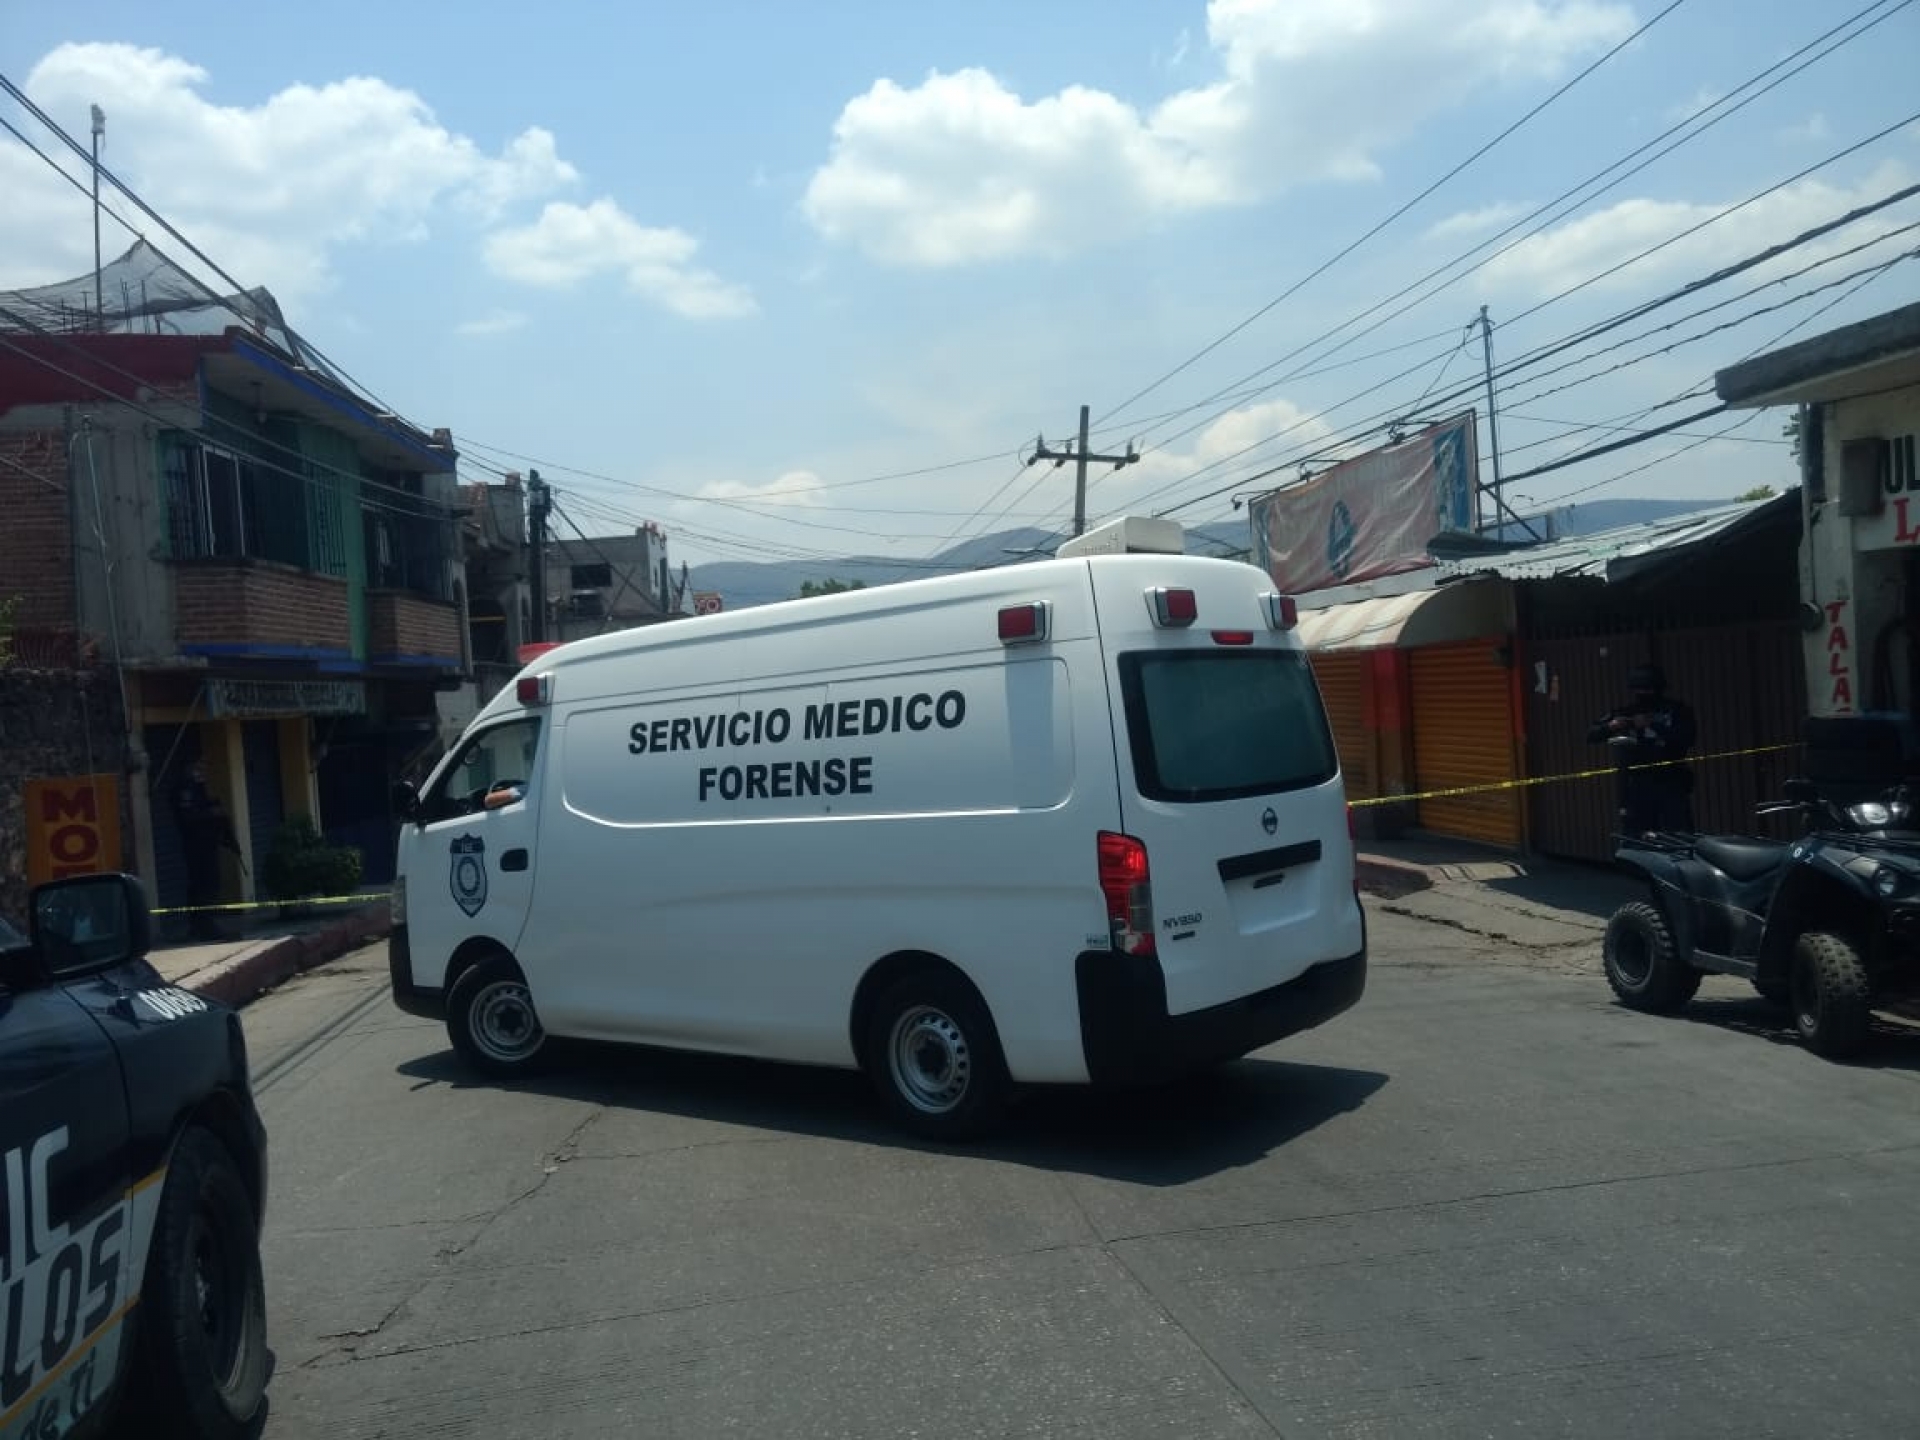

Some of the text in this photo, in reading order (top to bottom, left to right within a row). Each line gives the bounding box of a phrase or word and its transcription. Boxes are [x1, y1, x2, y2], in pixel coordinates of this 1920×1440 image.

[1824, 600, 1852, 713] TALA
[628, 690, 967, 754] SERVICIO MEDICO
[699, 756, 874, 802] FORENSE
